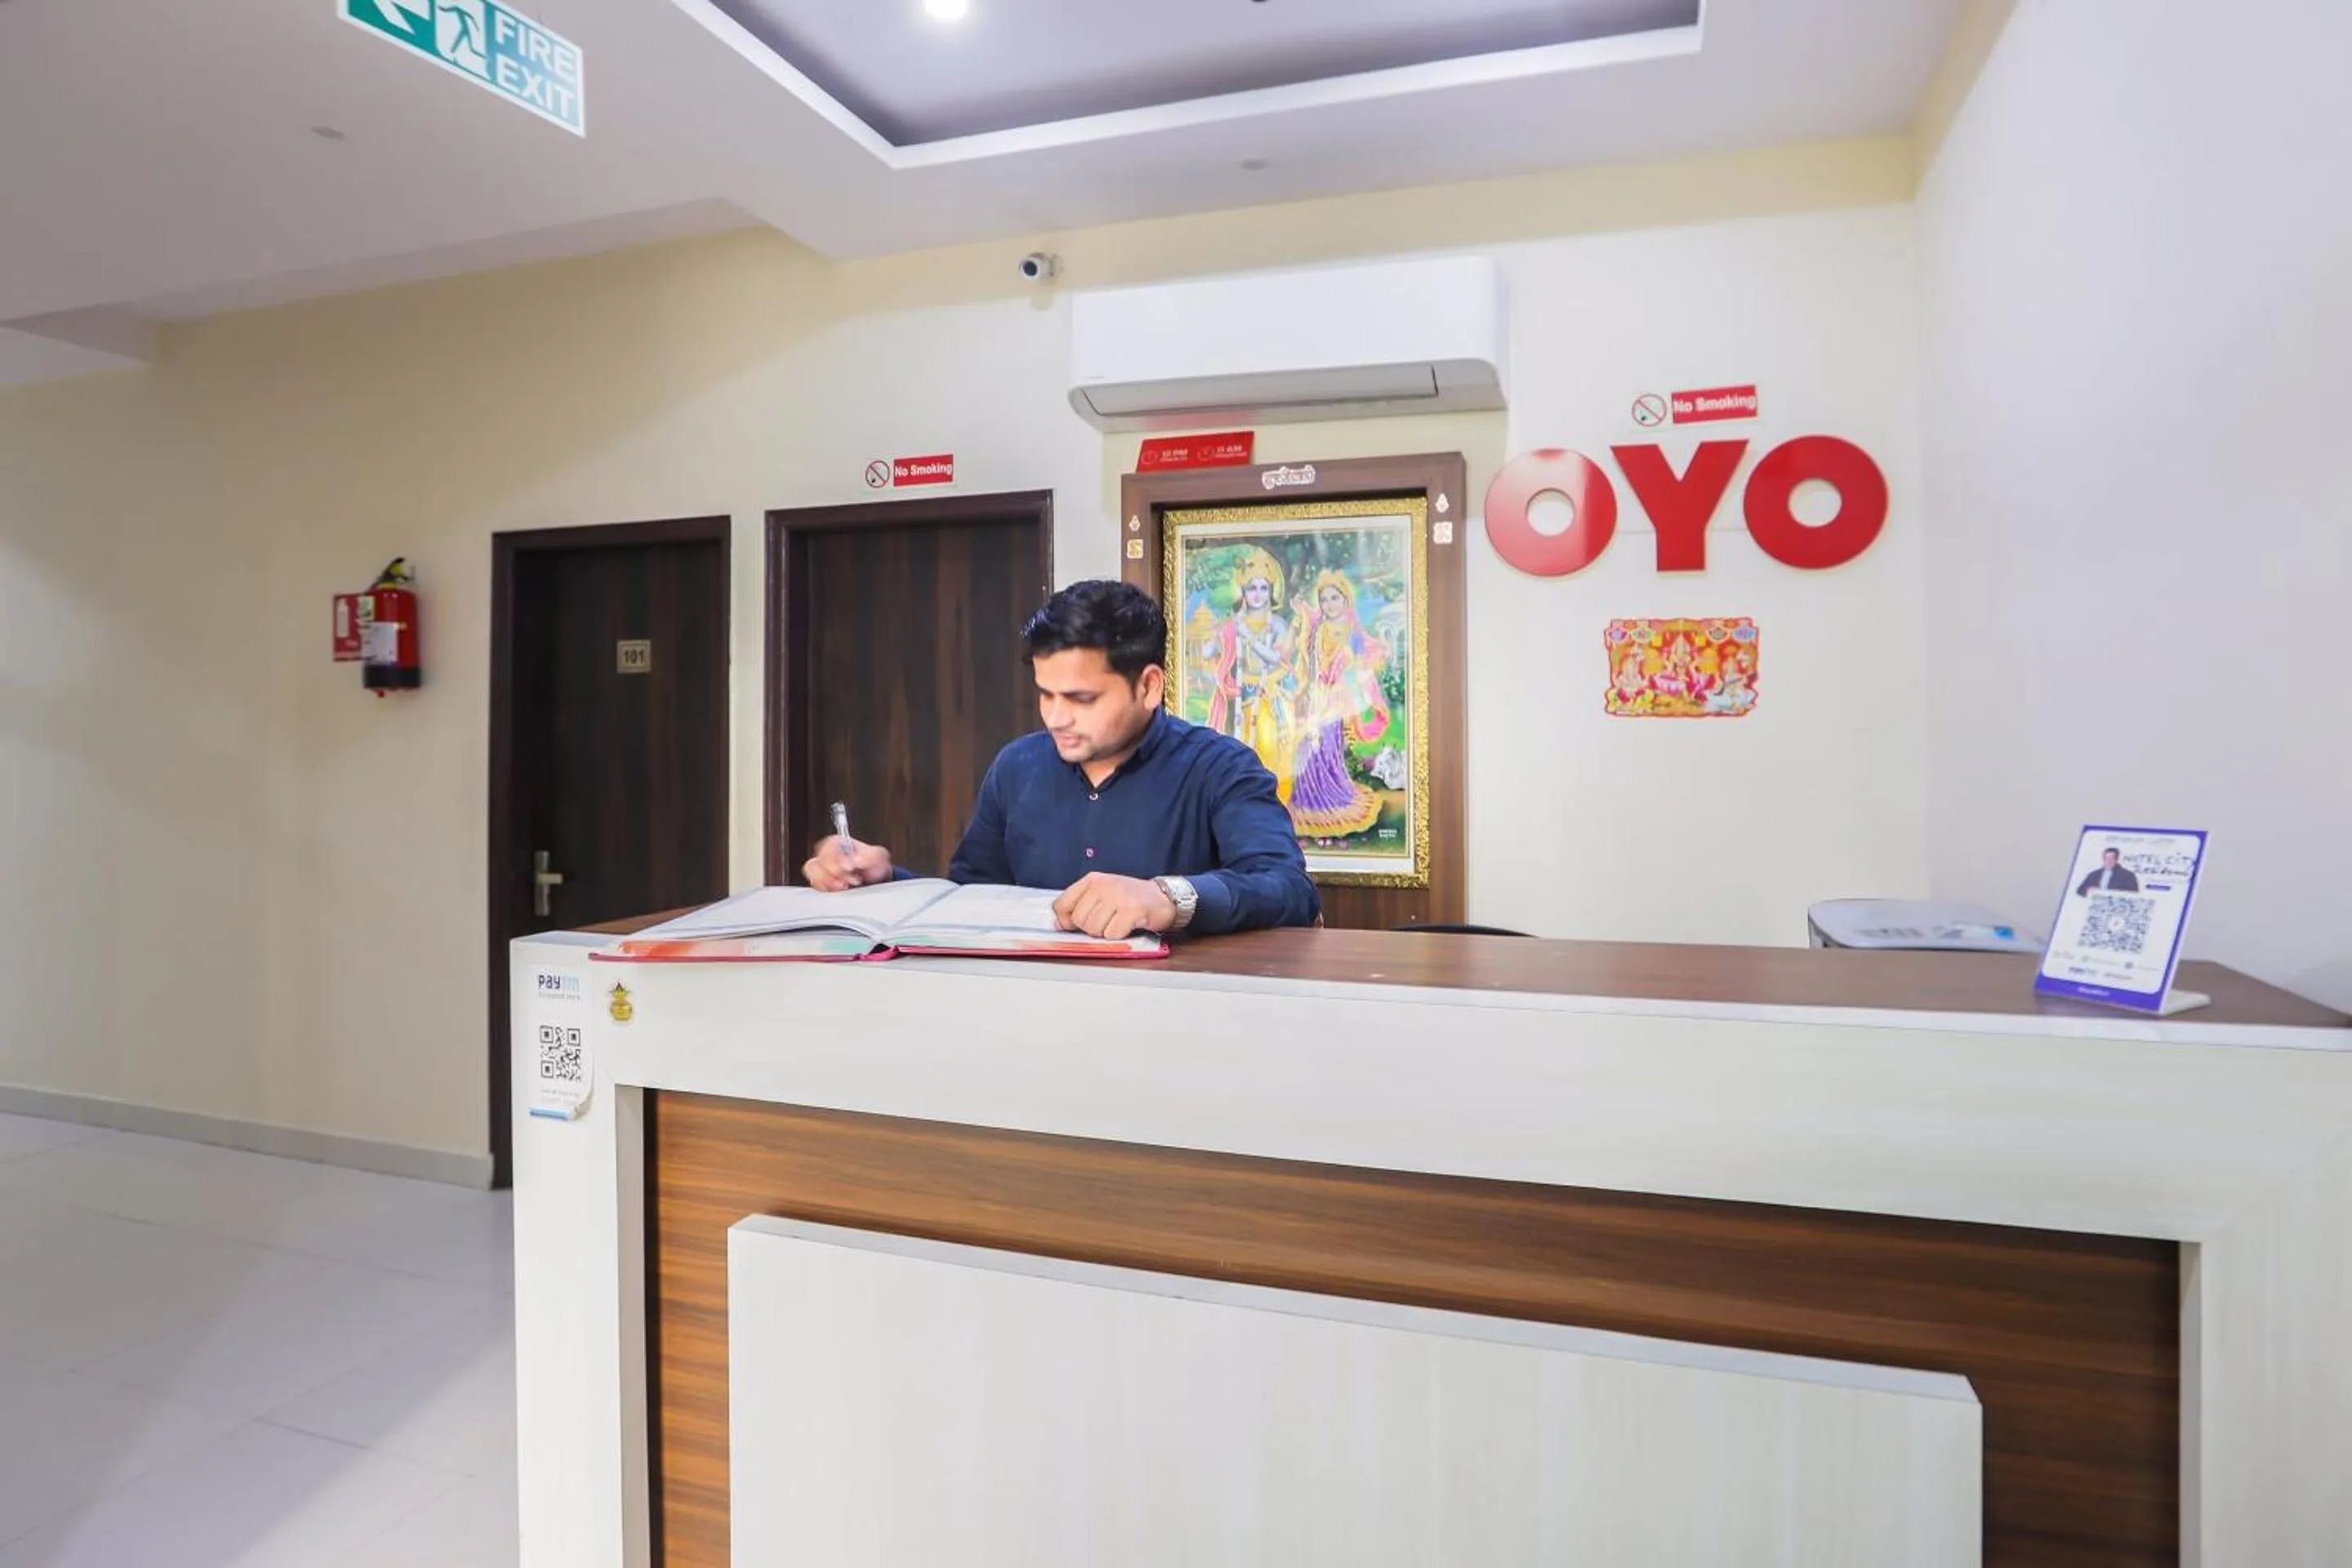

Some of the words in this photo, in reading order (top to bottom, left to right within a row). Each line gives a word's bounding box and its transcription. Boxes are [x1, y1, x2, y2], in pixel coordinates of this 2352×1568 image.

[494, 10, 577, 82] FIRE
[494, 52, 575, 119] EXIT
[1673, 399, 1692, 413] No
[1695, 394, 1756, 412] Smoking
[895, 466, 908, 477] No
[911, 461, 952, 476] Smoking
[1484, 434, 1889, 577] OYO
[624, 649, 644, 665] 101
